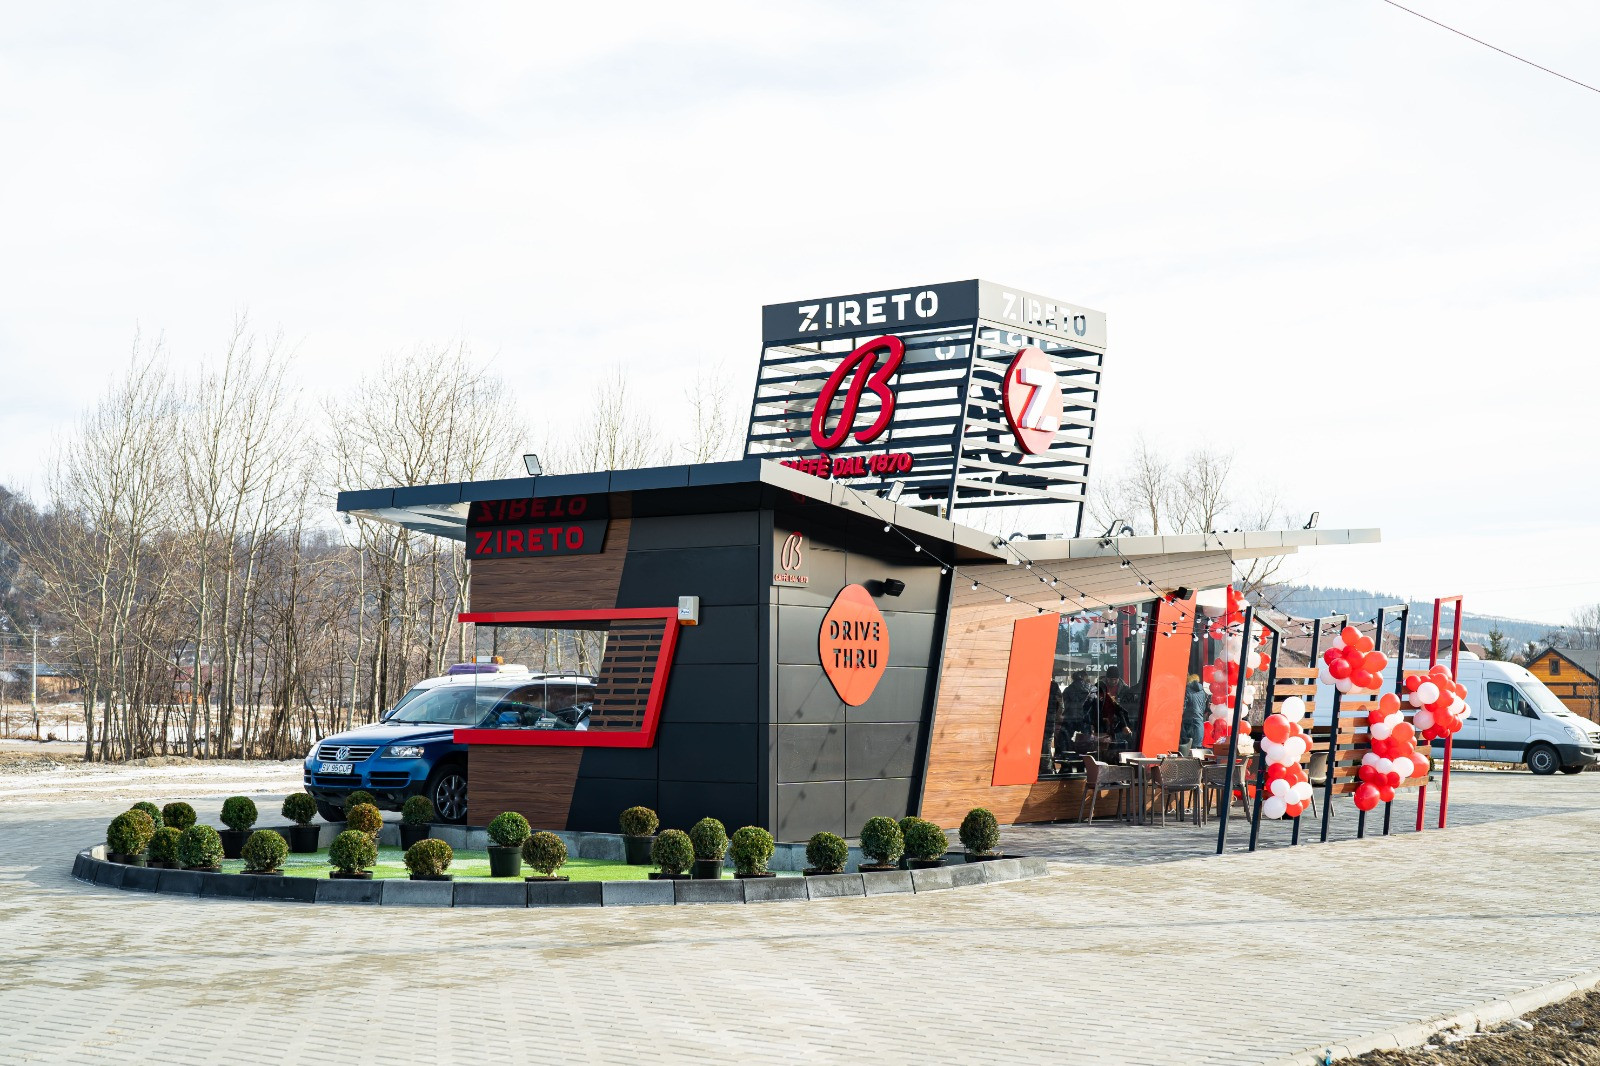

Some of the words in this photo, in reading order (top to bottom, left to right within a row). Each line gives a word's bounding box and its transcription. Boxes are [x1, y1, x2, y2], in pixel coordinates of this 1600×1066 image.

[798, 290, 939, 333] ZIRETO
[1002, 291, 1087, 337] ZIRETO
[810, 334, 905, 450] B
[832, 457, 867, 478] DAL
[868, 453, 912, 474] 1870
[475, 526, 584, 555] ZIRETO
[781, 532, 802, 570] B
[830, 620, 880, 641] DRIVE
[833, 648, 877, 669] THRU
